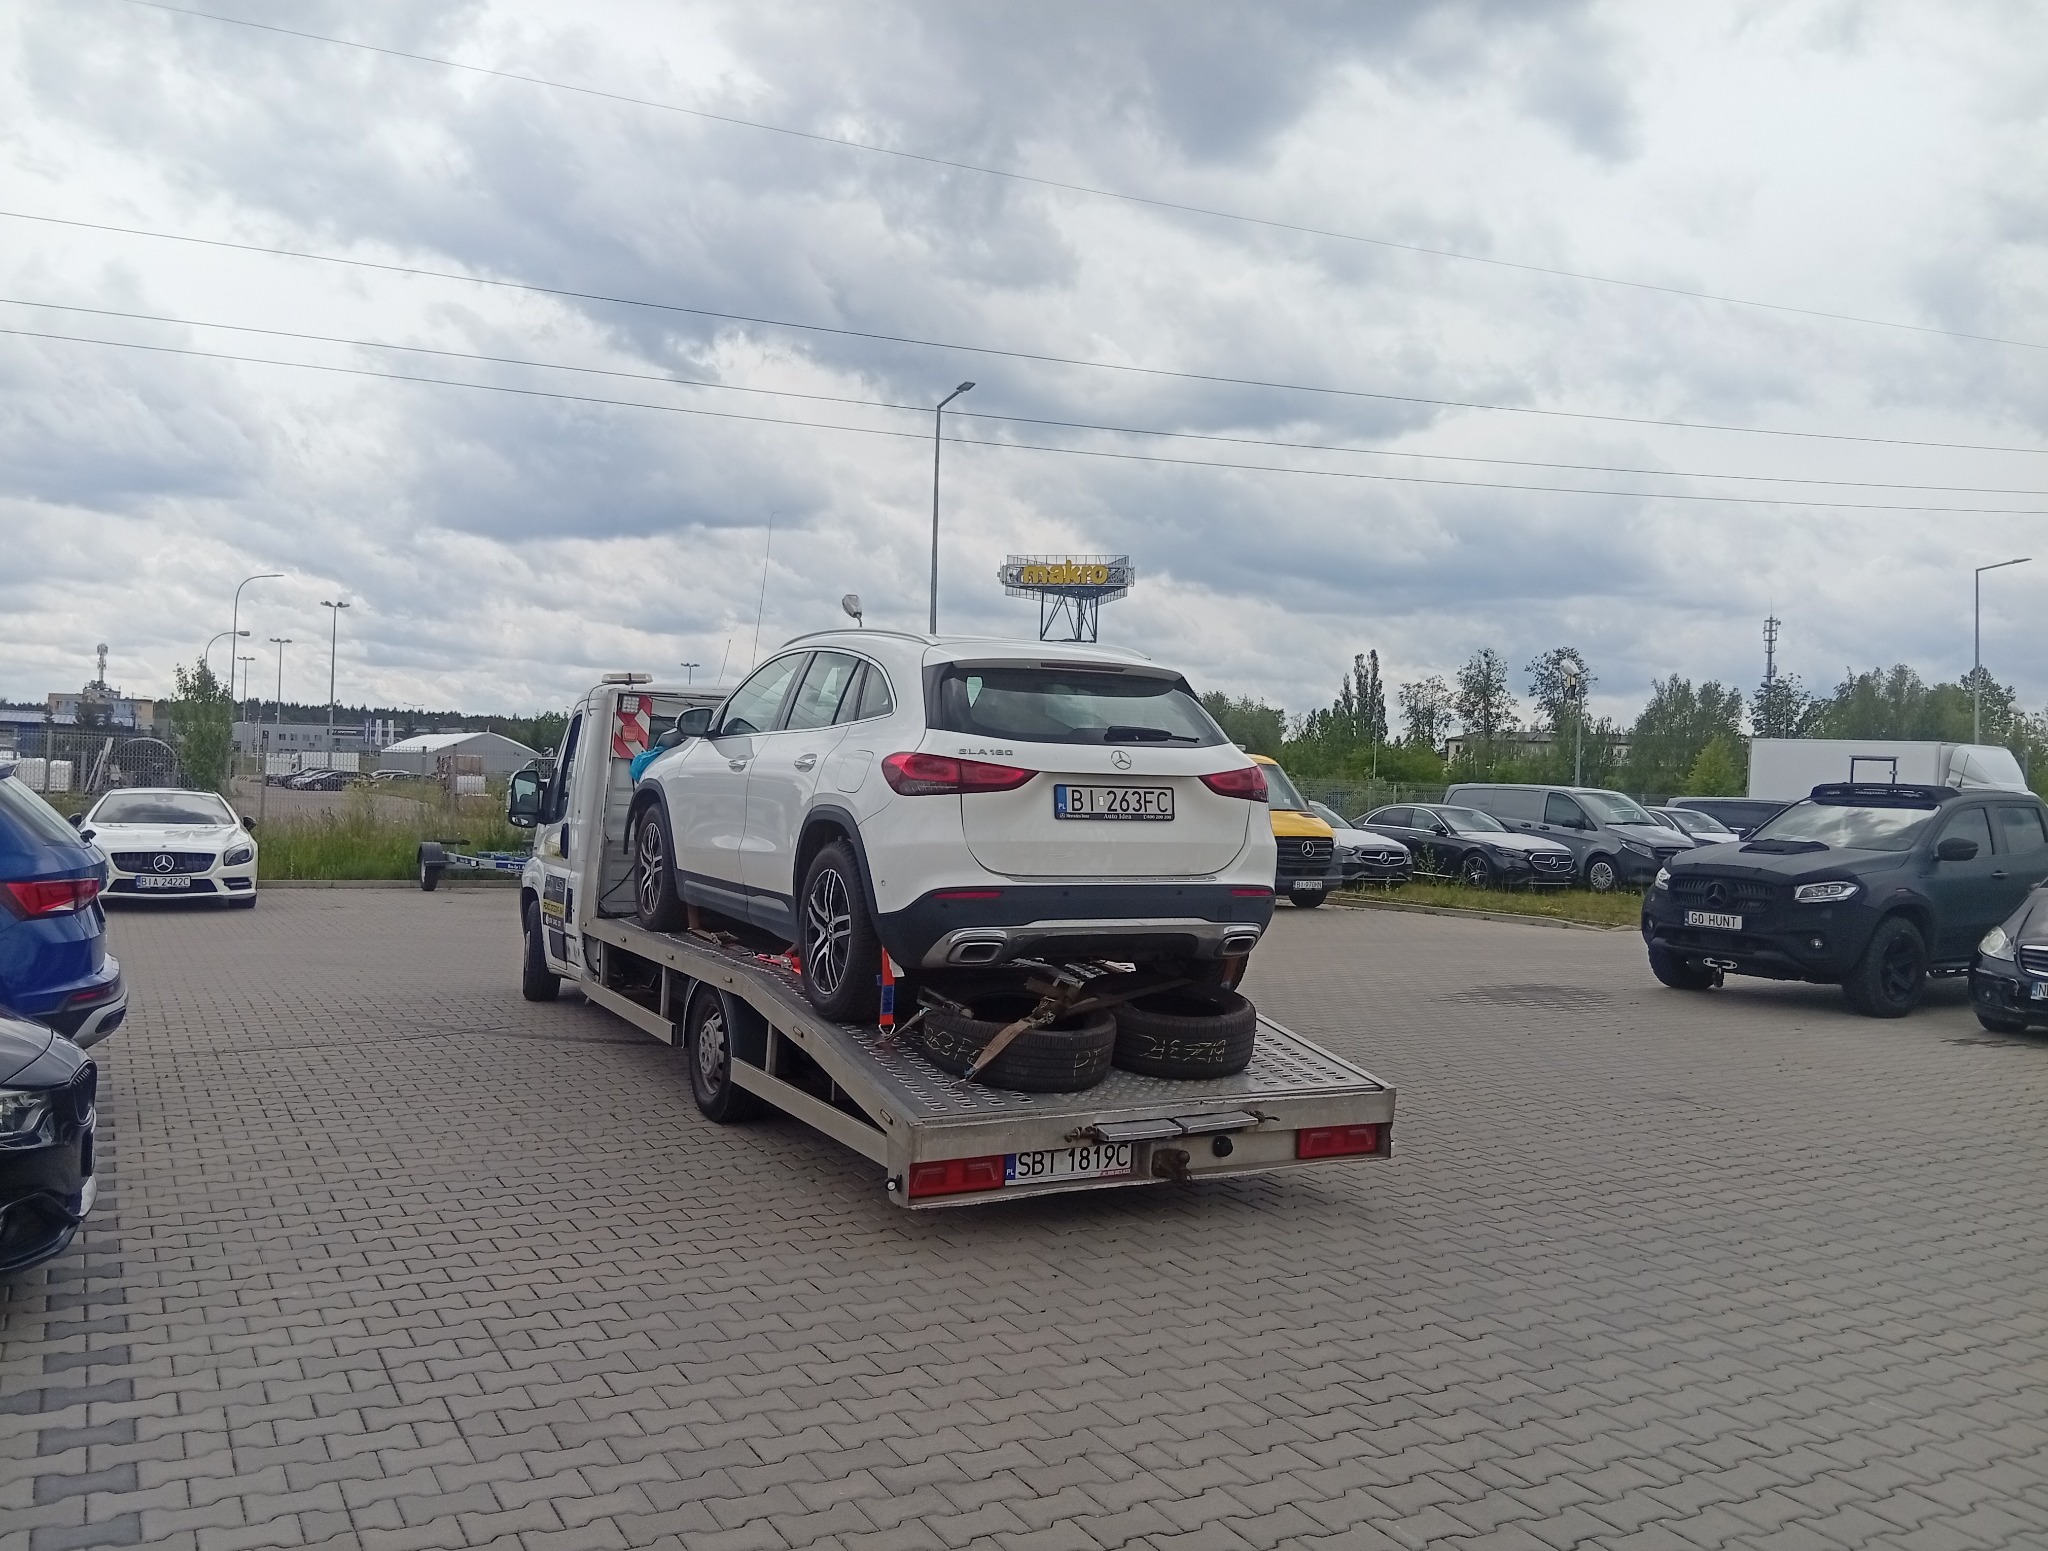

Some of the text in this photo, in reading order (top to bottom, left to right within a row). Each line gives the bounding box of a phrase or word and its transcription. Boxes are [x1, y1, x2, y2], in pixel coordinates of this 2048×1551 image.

[1023, 560, 1109, 584] makro
[958, 748, 988, 756] GLA
[1071, 789, 1168, 813] BI 263FC
[141, 877, 190, 887] BIA 2422C
[1708, 914, 1737, 928] HUNT
[1068, 1144, 1130, 1172] 1819C
[1006, 1168, 1015, 1176] PL
